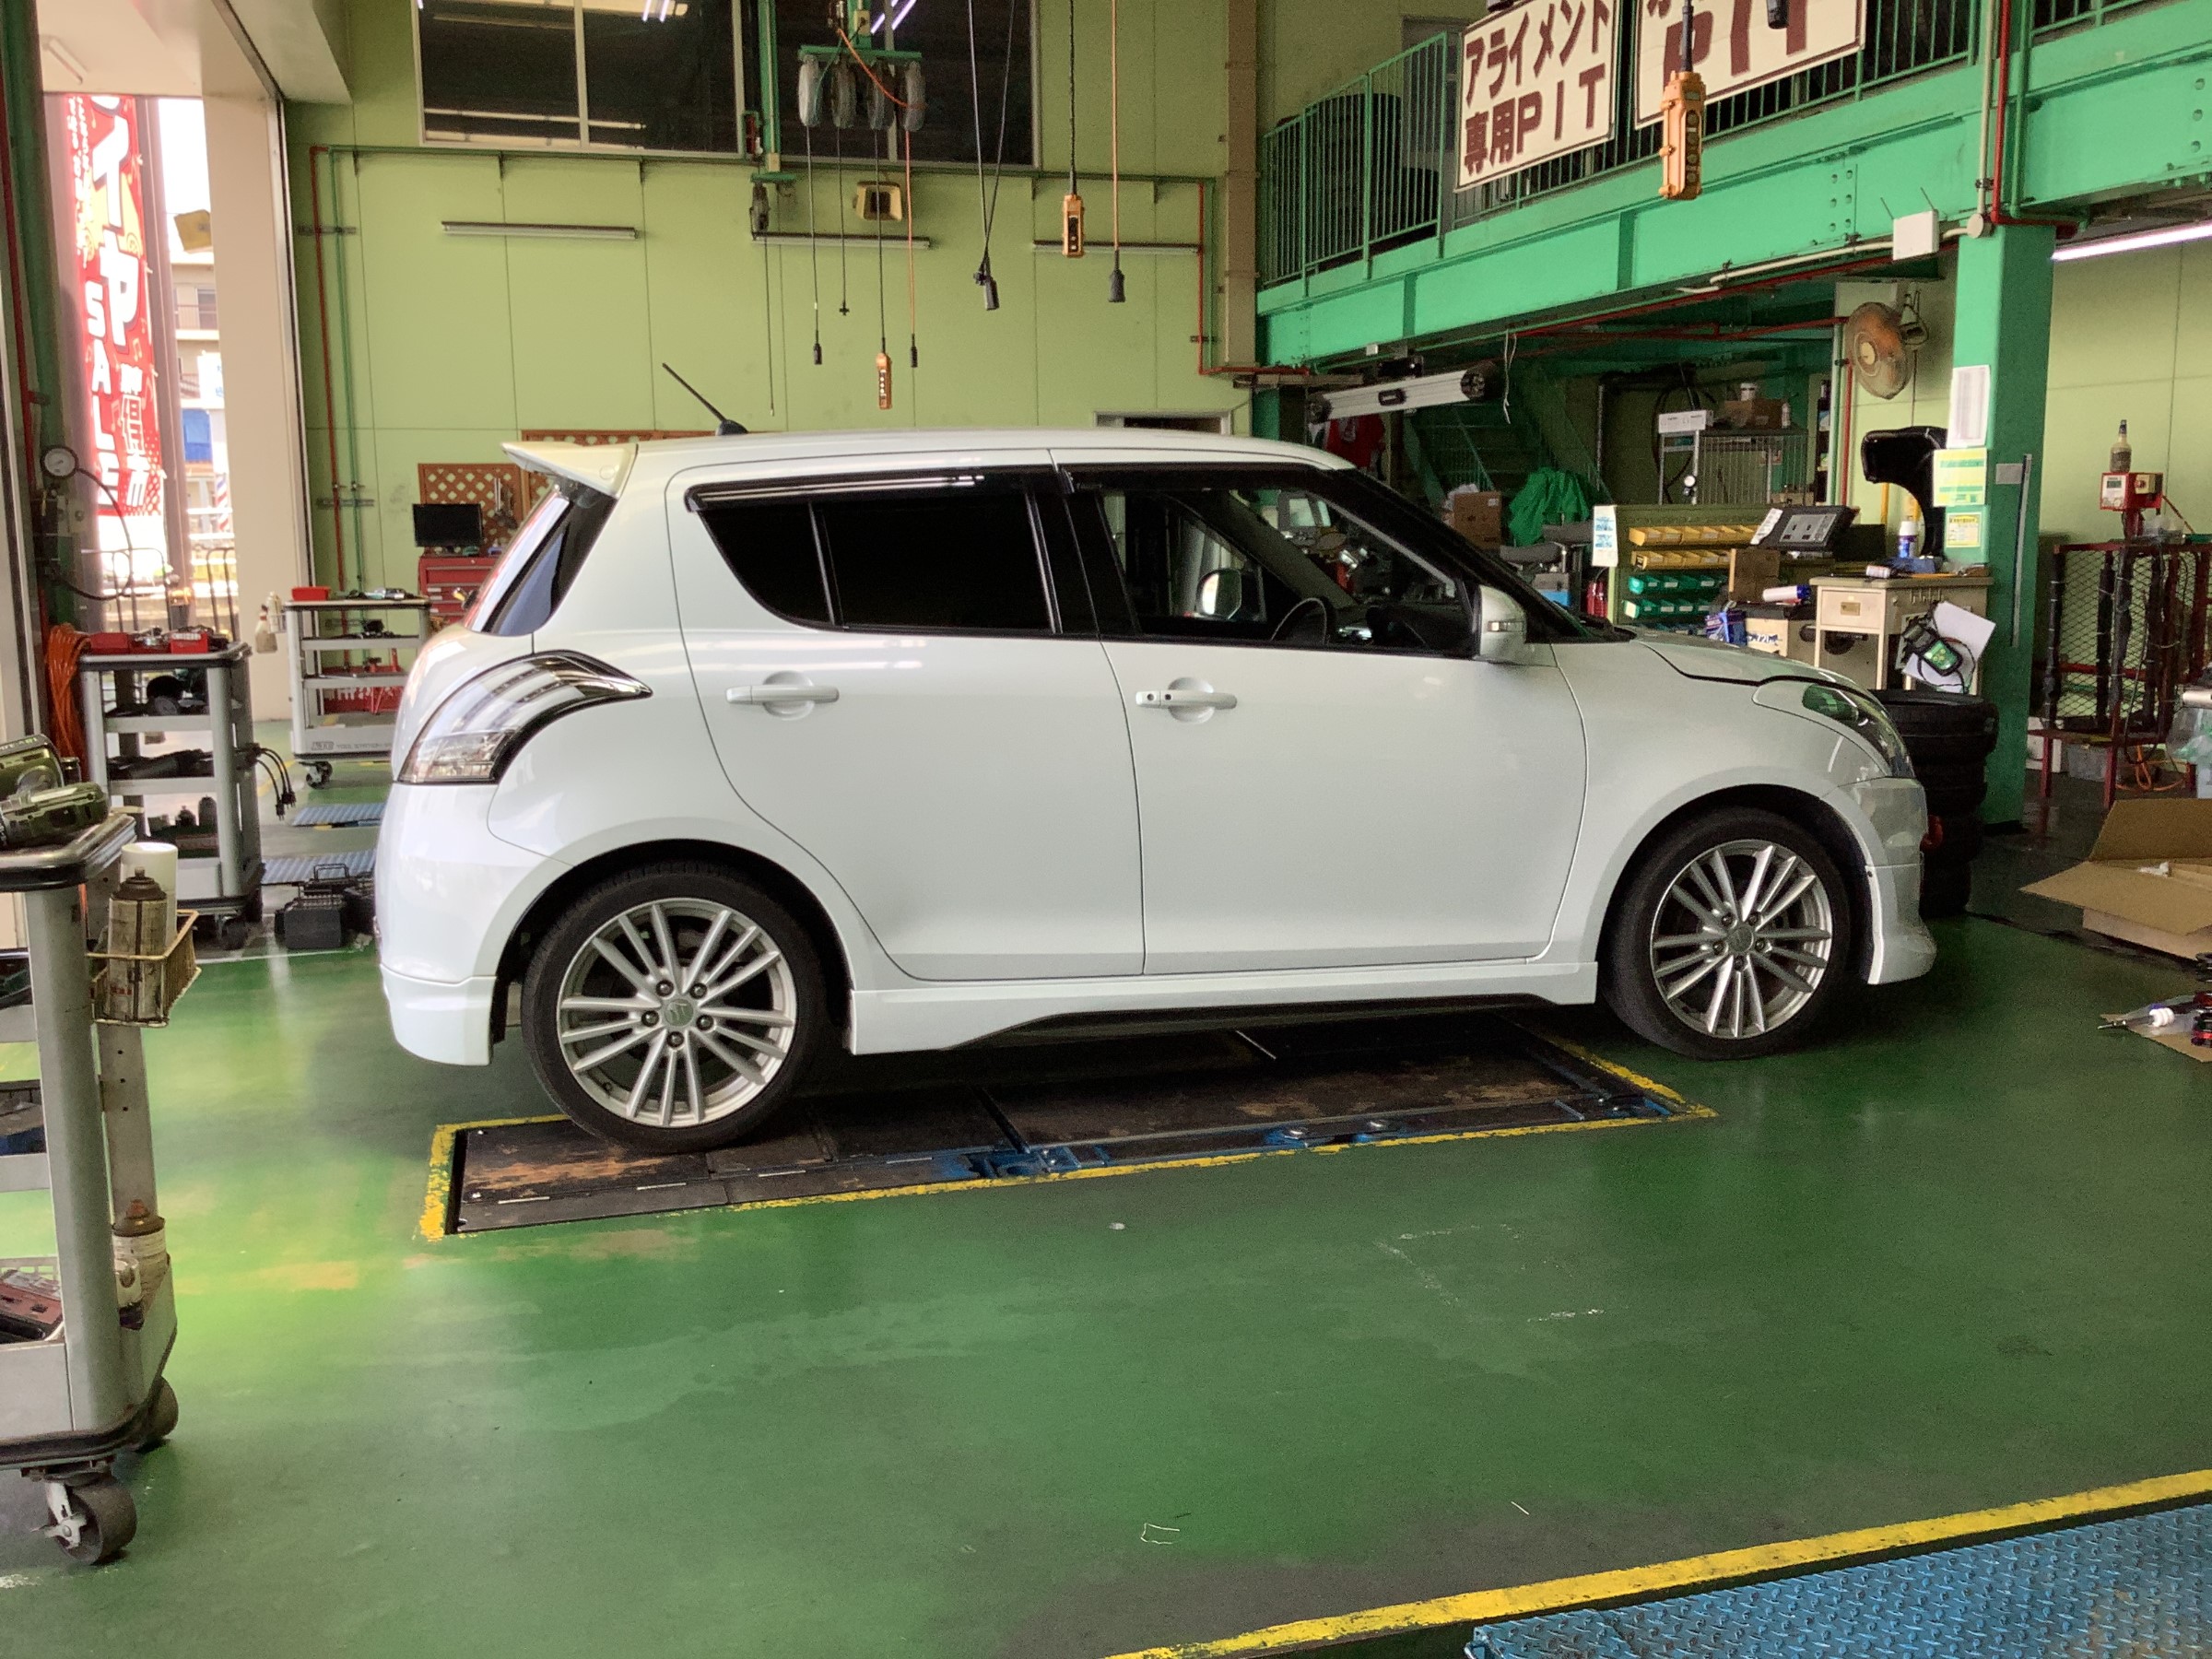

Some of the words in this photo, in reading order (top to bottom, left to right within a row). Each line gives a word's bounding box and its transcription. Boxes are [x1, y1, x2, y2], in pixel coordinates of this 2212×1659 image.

[1465, 0, 1610, 108] アライメント
[91, 95, 139, 347] イヤ
[85, 280, 119, 505] SALE
